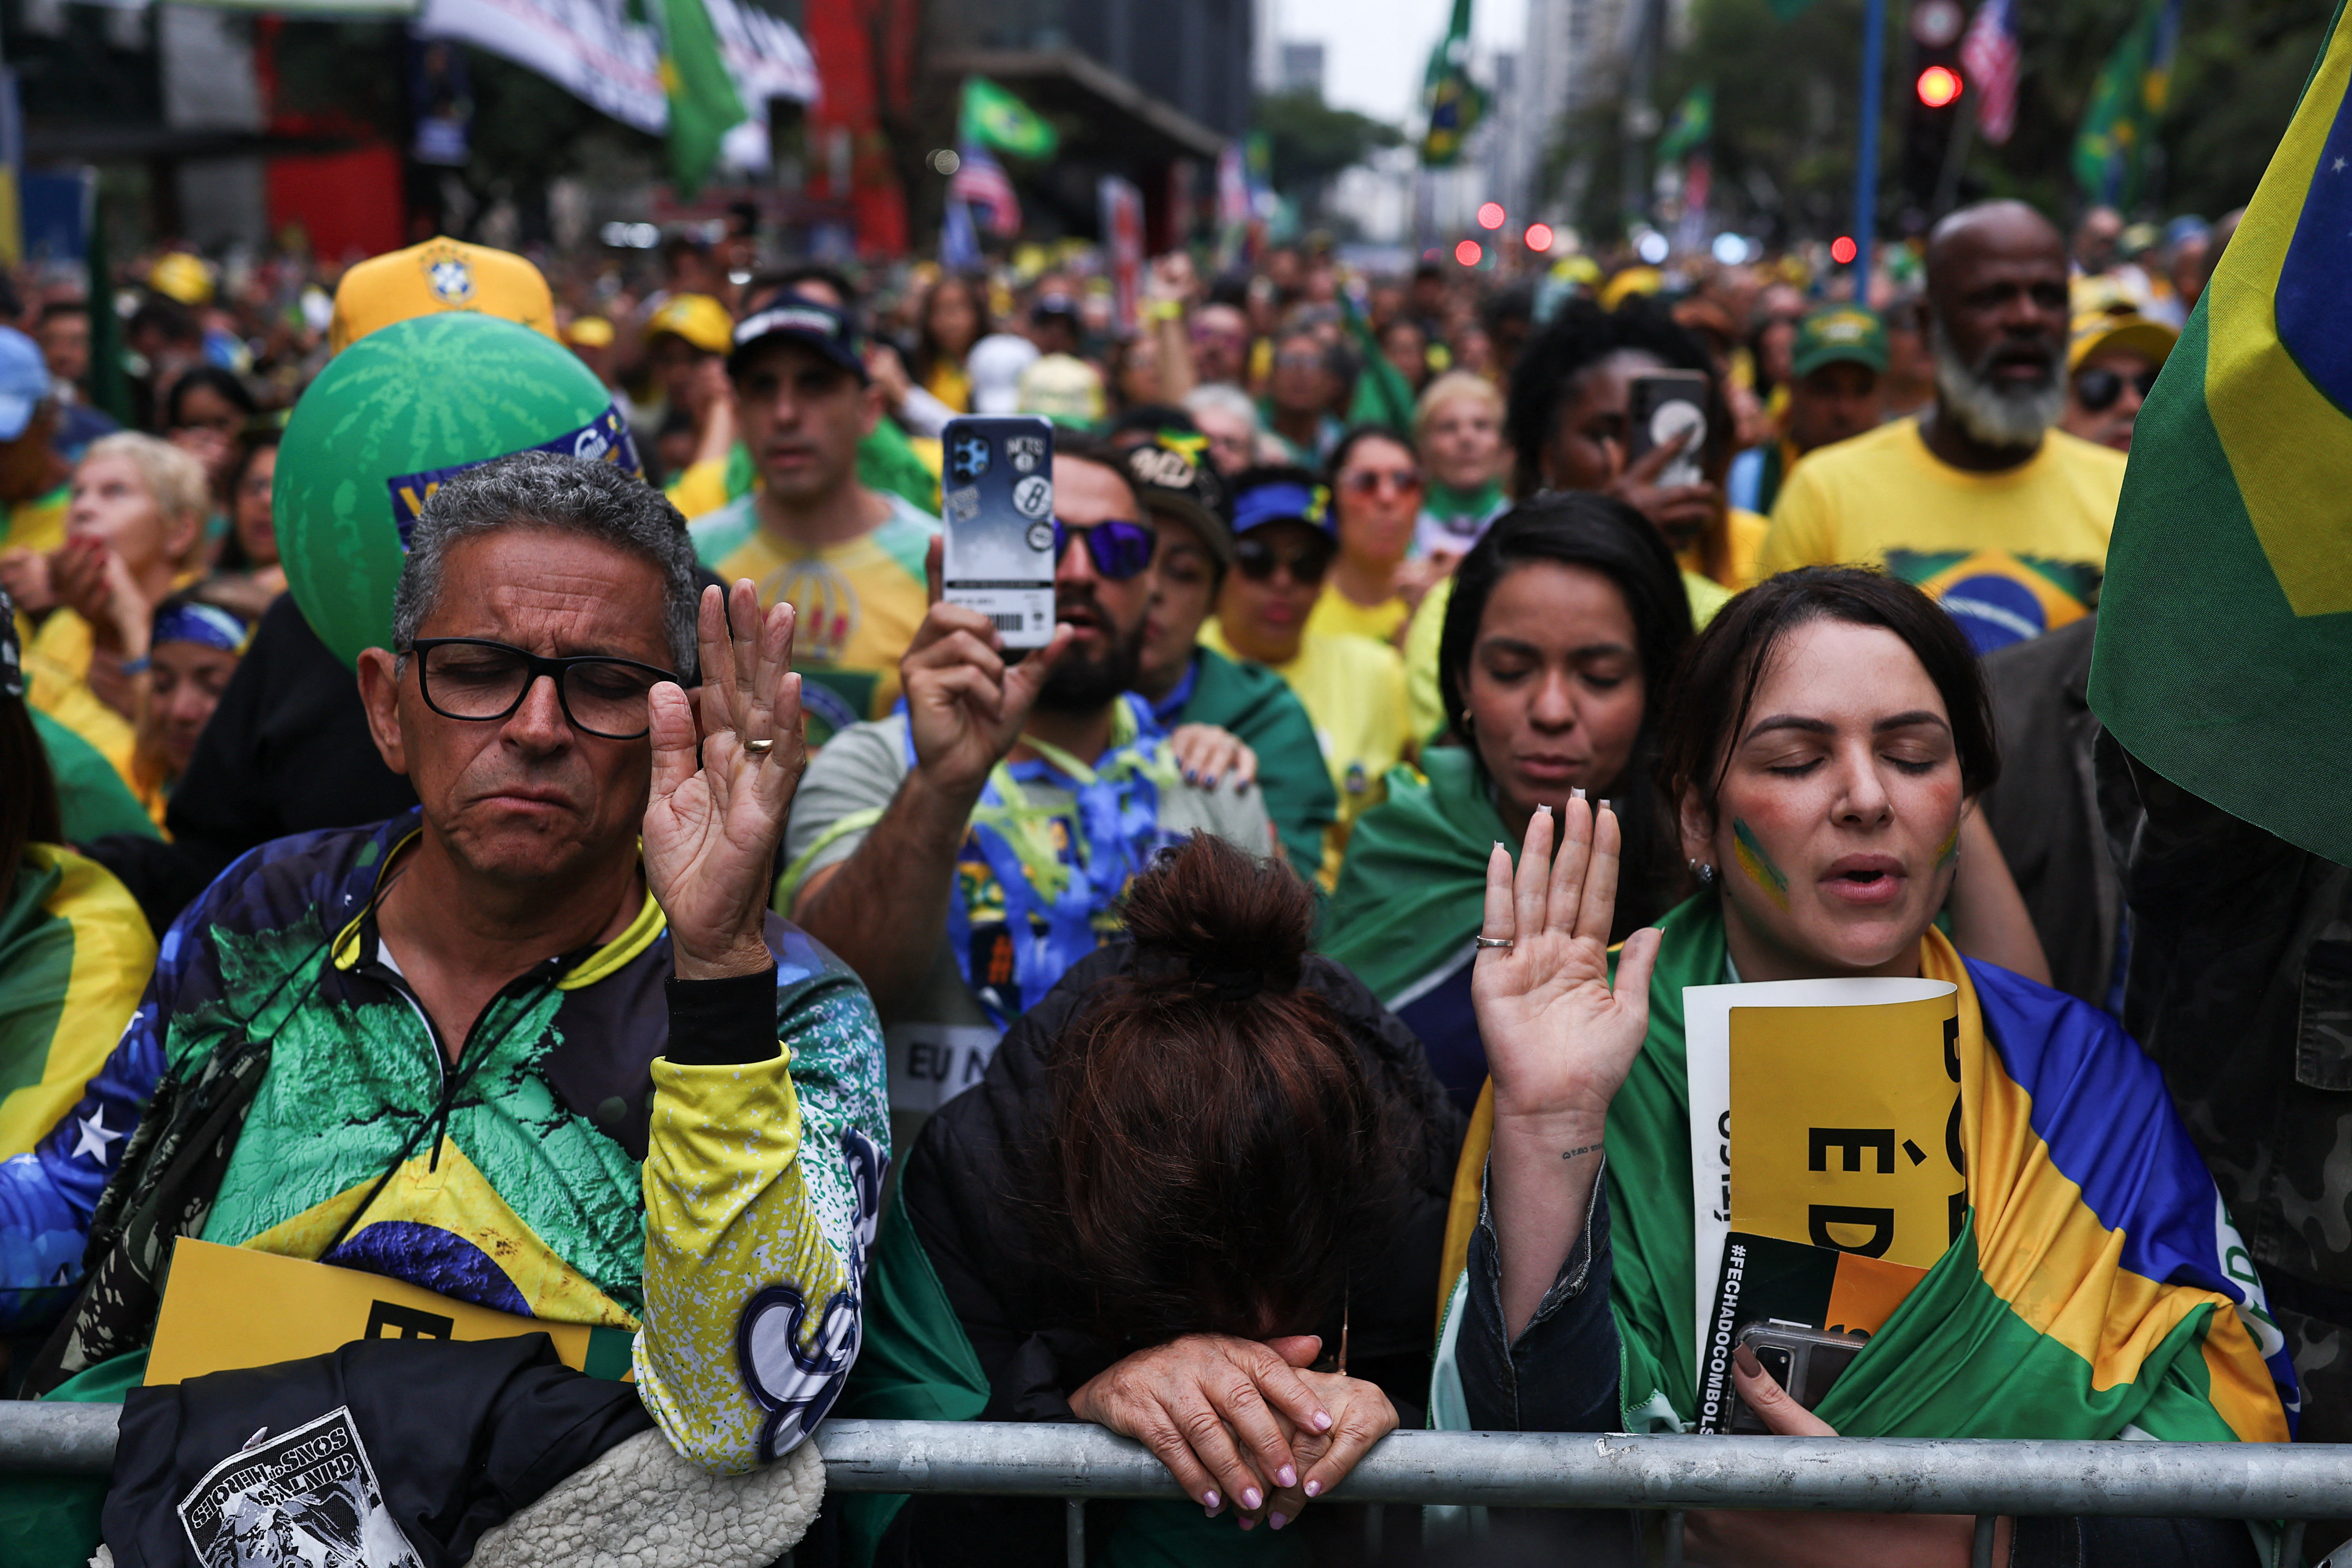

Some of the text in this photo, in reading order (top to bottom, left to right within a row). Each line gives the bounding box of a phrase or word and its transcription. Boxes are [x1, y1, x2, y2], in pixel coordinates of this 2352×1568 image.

[908, 1043, 953, 1082] EU
[280, 1427, 348, 1472] SONS
[192, 1463, 269, 1528] HEROES
